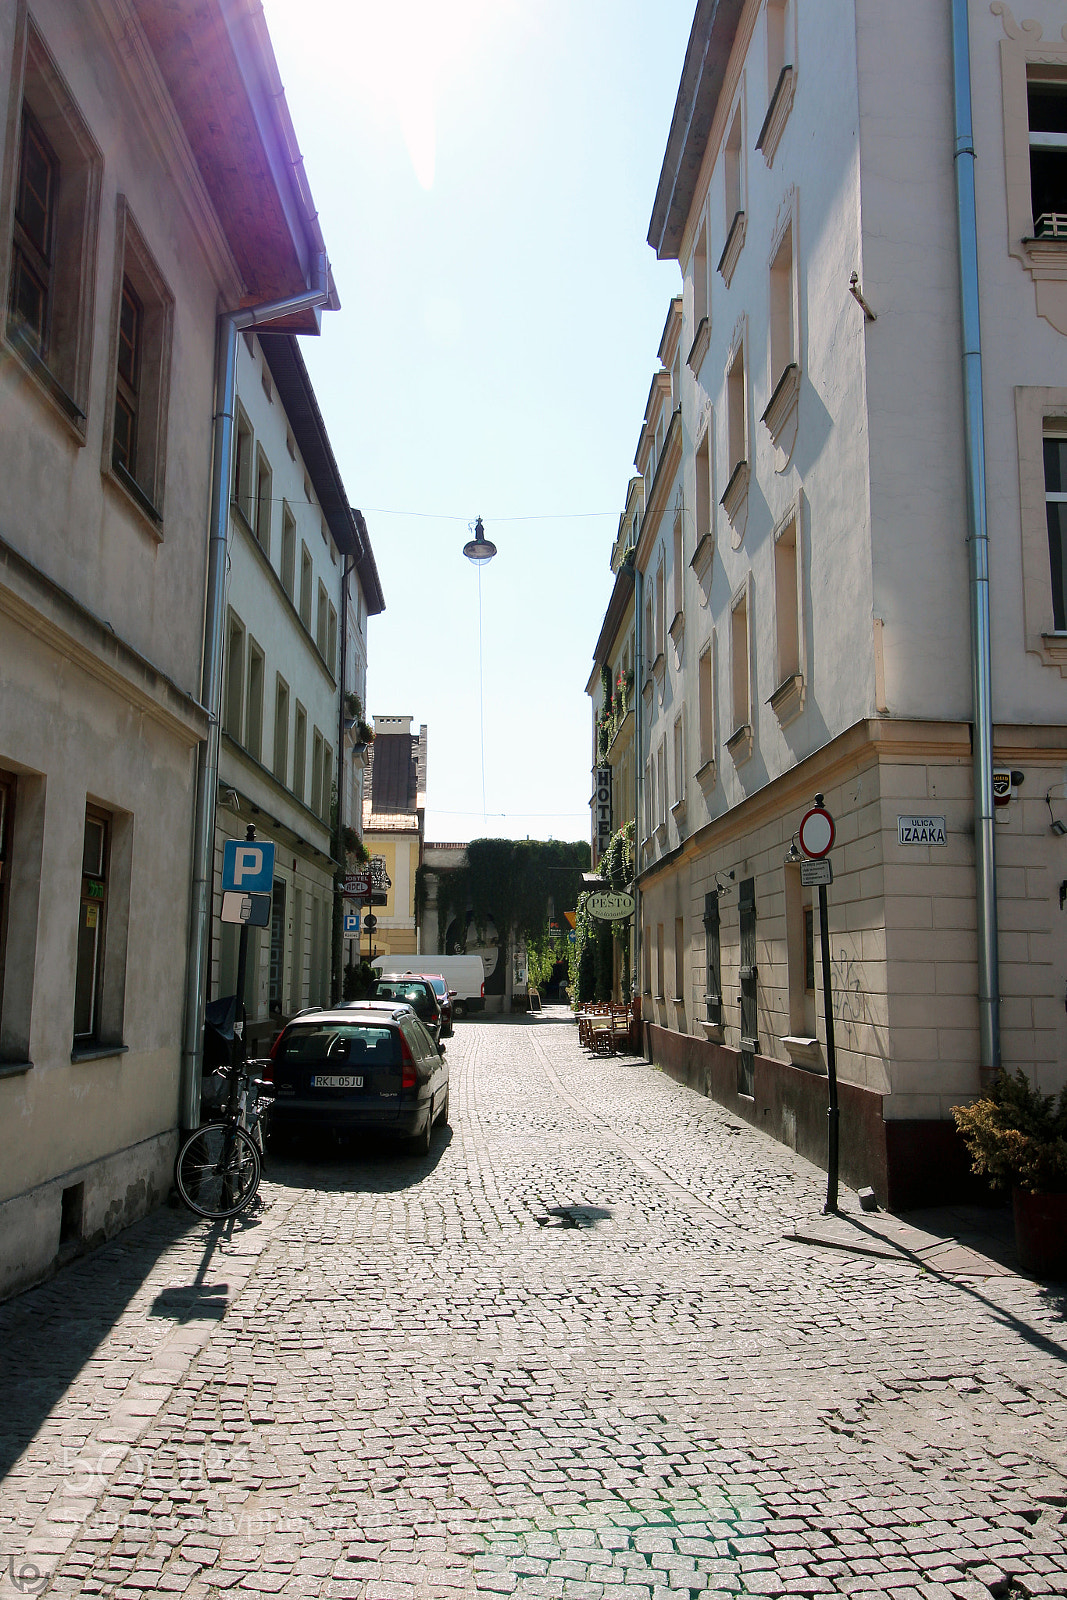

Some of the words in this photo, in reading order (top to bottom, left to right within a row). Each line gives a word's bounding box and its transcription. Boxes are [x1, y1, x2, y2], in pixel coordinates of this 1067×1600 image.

[598, 771, 610, 852] HOTEL
[911, 819, 934, 827] ULICA
[901, 827, 945, 842] IZAAKA
[233, 847, 264, 885] P
[591, 898, 632, 908] PESTO
[346, 916, 357, 930] P
[315, 1076, 335, 1087] RKL
[338, 1076, 363, 1087] 05JU
